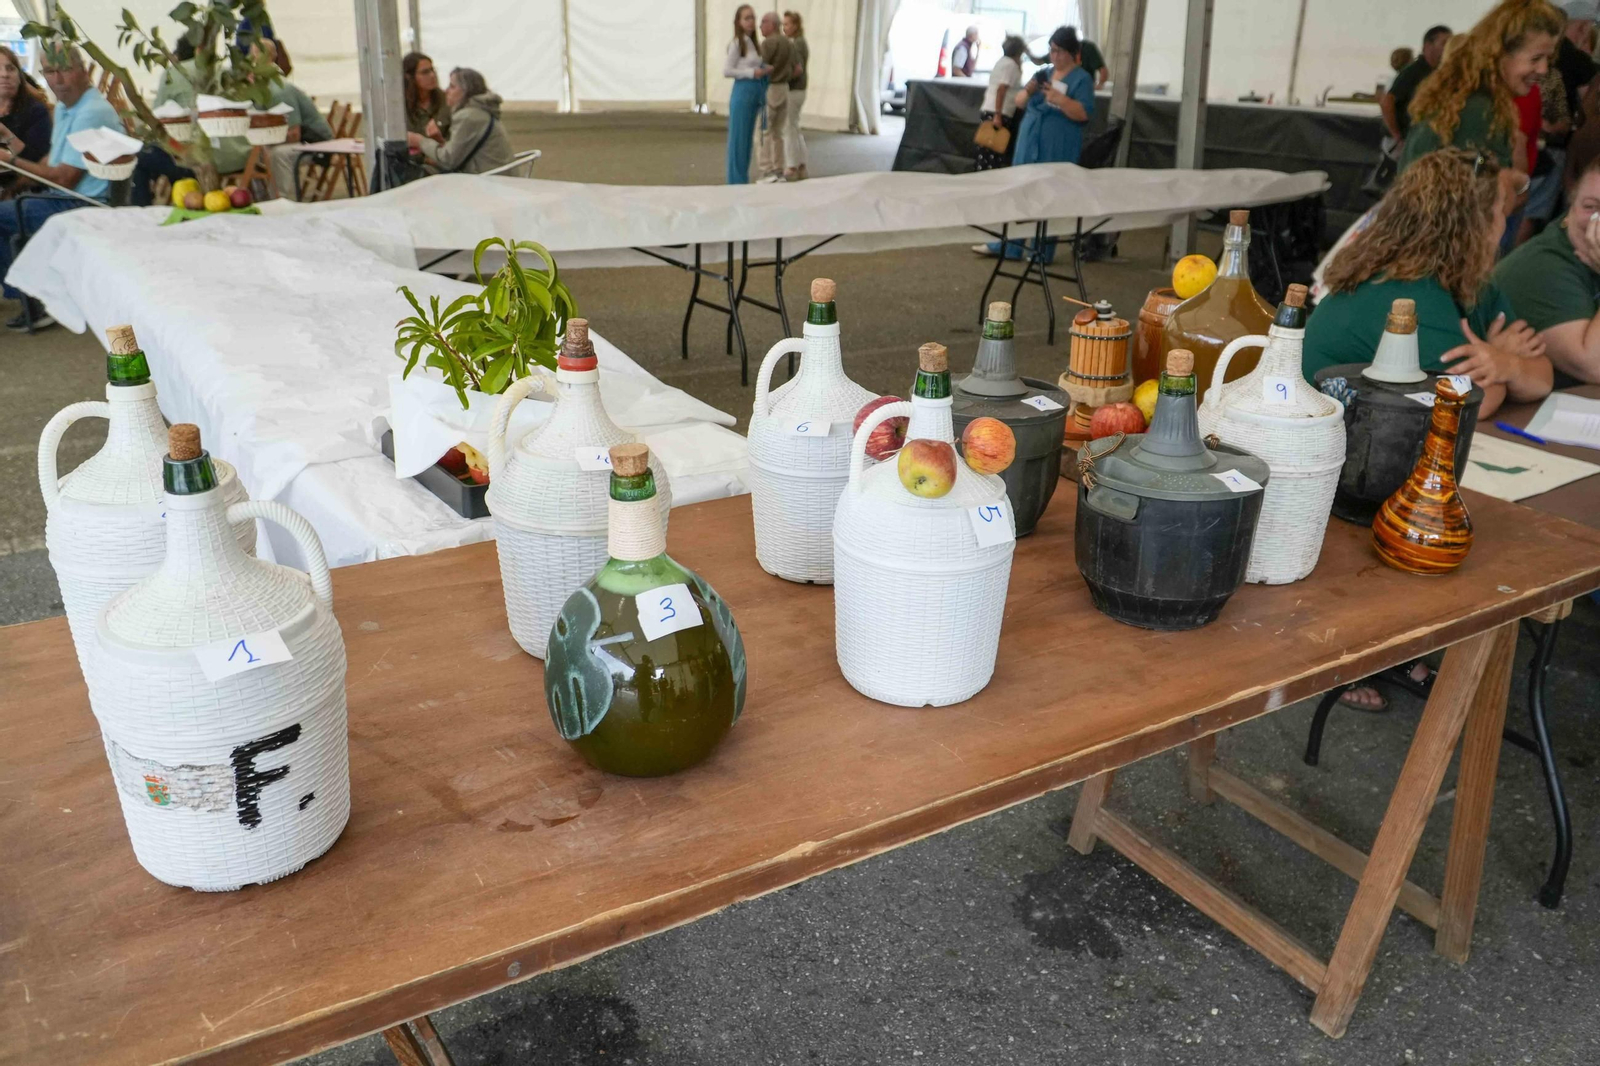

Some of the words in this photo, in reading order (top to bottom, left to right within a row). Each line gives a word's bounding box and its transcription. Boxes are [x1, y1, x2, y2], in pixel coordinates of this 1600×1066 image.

[1276, 383, 1287, 400] 9
[796, 421, 811, 433] 6
[1226, 475, 1242, 486] 7
[978, 505, 1002, 523] 5
[659, 597, 676, 623] 3
